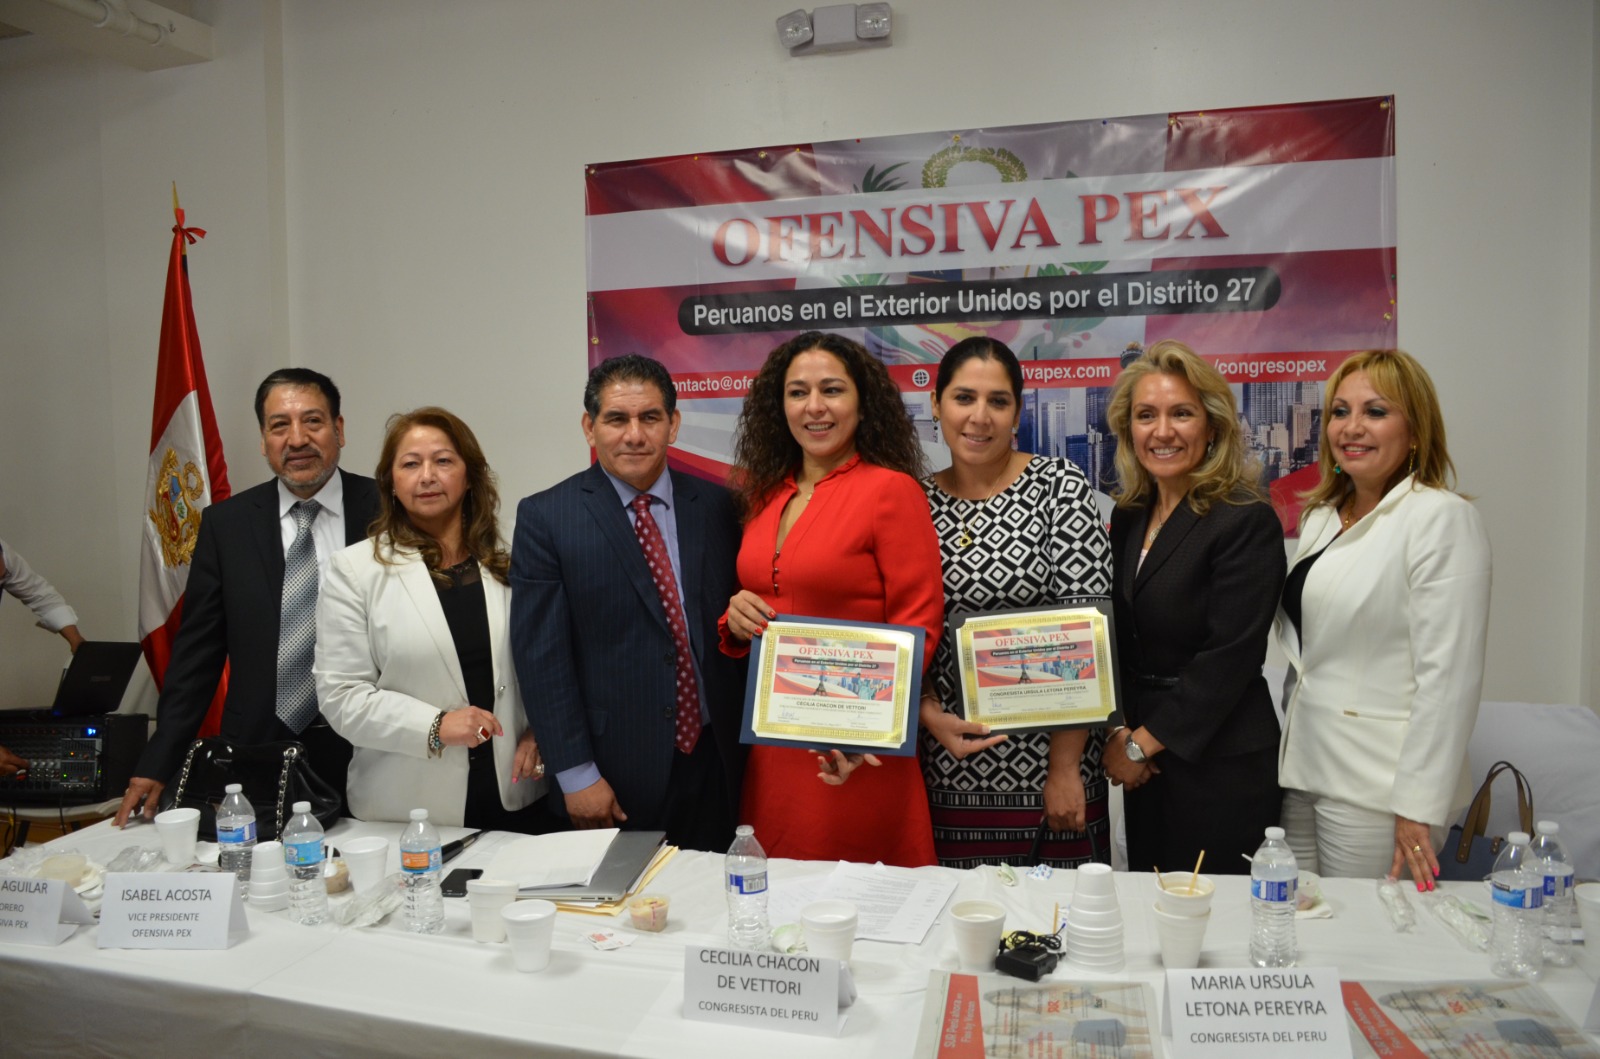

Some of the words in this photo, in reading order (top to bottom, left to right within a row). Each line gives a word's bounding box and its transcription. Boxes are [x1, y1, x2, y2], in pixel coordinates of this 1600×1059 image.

[712, 197, 1061, 268] OFENSIVA
[1079, 186, 1229, 245] PEX
[694, 301, 793, 326] Peruanos
[800, 300, 826, 320] en
[834, 296, 852, 318] el
[860, 291, 951, 317] Exterior
[958, 283, 1042, 314] Unidos
[1050, 288, 1090, 314] por
[1098, 282, 1118, 306] el
[1128, 279, 1218, 306] Distrito
[1227, 277, 1256, 302] 27
[995, 636, 1048, 647] OFENSIVA
[1049, 633, 1070, 642] PEX
[799, 646, 850, 658] OFENSIVA
[854, 651, 874, 659] PEX
[1, 880, 48, 894] AGUILAR
[121, 889, 162, 901] ISABEL
[165, 889, 212, 901] ACOSTA
[15, 920, 28, 928] PEX
[150, 913, 199, 921] PRESIDENTE
[132, 929, 173, 937] OFENSIVA
[176, 929, 191, 937] PEX
[700, 949, 753, 967] CECILIA
[757, 954, 820, 973] CHACON
[717, 975, 736, 989] DE
[740, 977, 801, 995] VETTORI
[1191, 974, 1246, 990] MARIA
[1250, 973, 1314, 989] URSULA
[699, 1001, 767, 1017] CONGRESISTA
[770, 1008, 788, 1019] DEL
[792, 1009, 819, 1021] PERU
[1186, 1000, 1251, 1016] LETONA
[1255, 1000, 1327, 1016] PEREYRA
[1190, 1032, 1269, 1043] CONGRESISTA
[1273, 1031, 1293, 1042] DEL
[1297, 1031, 1327, 1042] PERU
